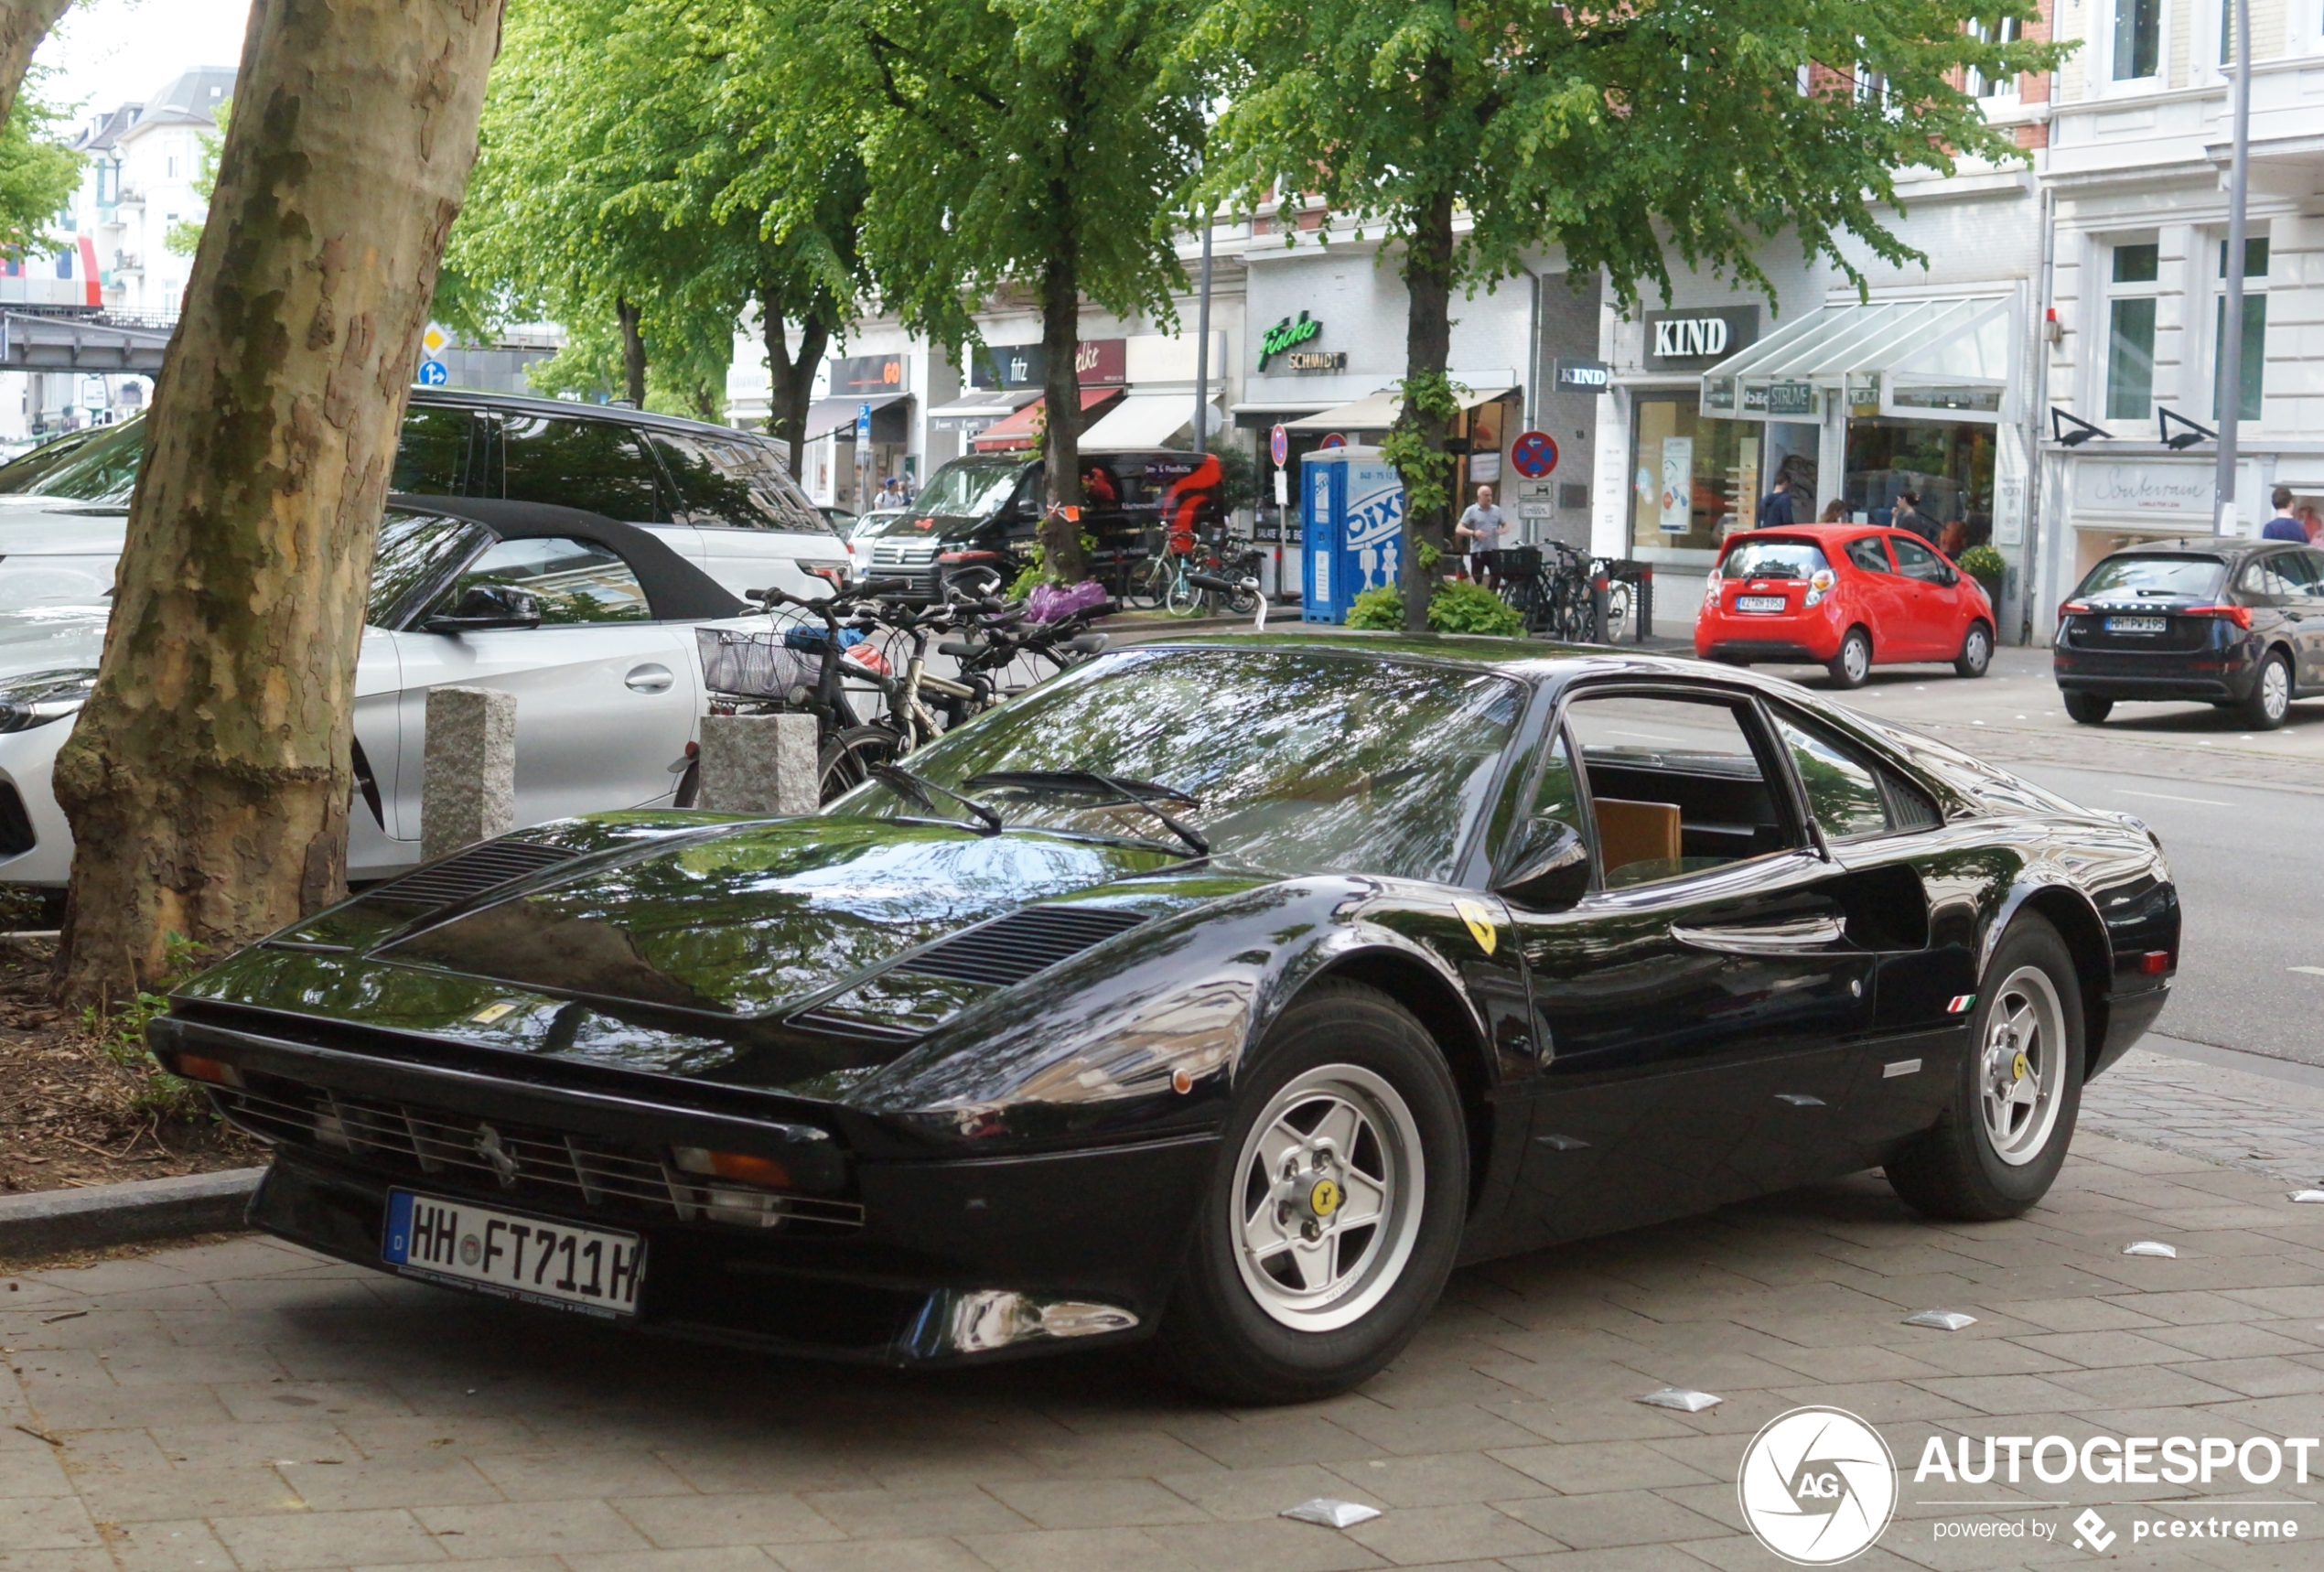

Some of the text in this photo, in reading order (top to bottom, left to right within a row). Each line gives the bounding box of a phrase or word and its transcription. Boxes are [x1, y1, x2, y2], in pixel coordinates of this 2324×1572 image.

[1258, 311, 1320, 371] Fische
[1652, 318, 1727, 356] KIND
[1288, 353, 1340, 370] SCHMIDT
[883, 362, 900, 384] GO
[1560, 369, 1607, 384] KIND
[2111, 619, 2124, 628] HH
[2146, 619, 2165, 630] 195
[411, 1203, 457, 1265] HH
